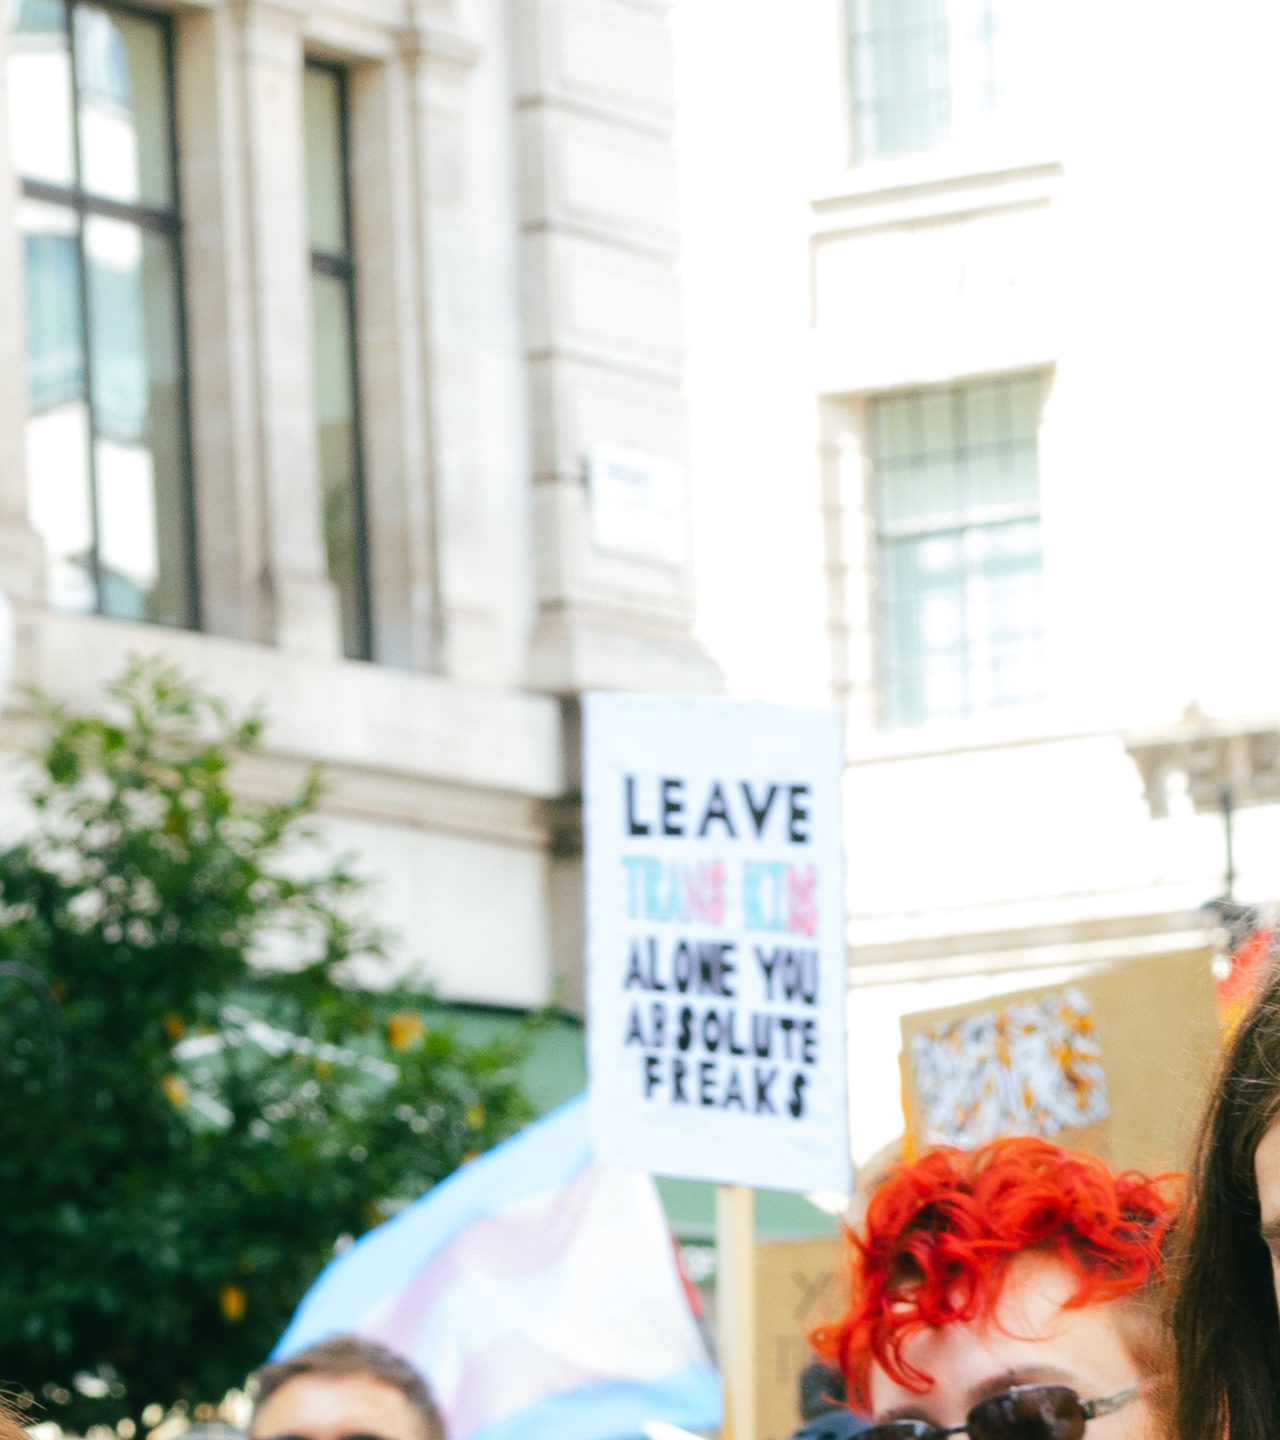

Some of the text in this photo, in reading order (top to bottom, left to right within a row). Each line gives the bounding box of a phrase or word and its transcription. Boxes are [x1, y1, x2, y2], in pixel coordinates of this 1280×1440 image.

[623, 774, 812, 844] LEAVE
[624, 937, 819, 1005] ALONE YOU
[624, 1001, 817, 1064] ABSOLUTE
[643, 1056, 808, 1120] FREAKS
